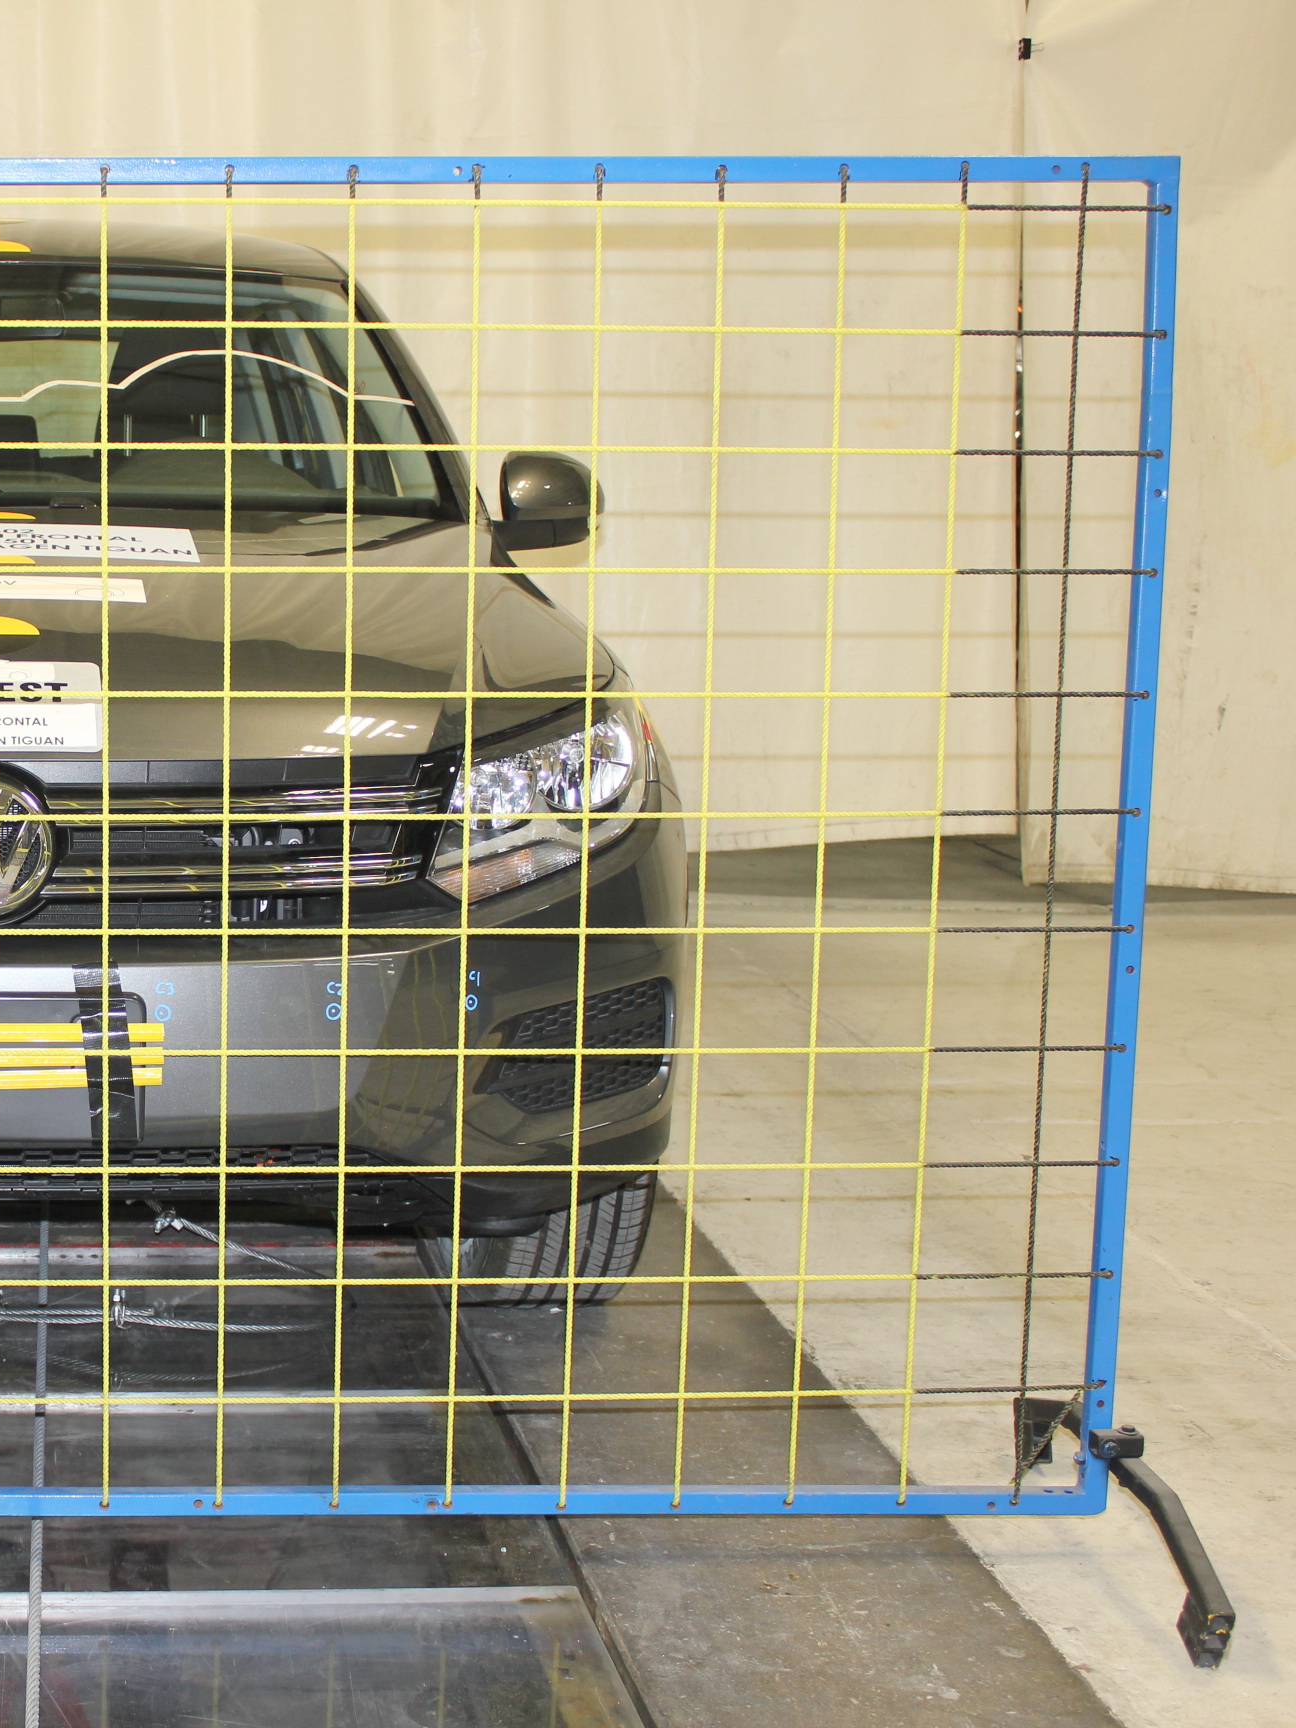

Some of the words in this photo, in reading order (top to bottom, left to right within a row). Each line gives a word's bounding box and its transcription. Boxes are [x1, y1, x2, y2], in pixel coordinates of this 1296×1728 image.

[17, 533, 142, 542] FRONTAL
[82, 544, 192, 555] TIGUAN
[11, 735, 64, 745] TIGUAN
